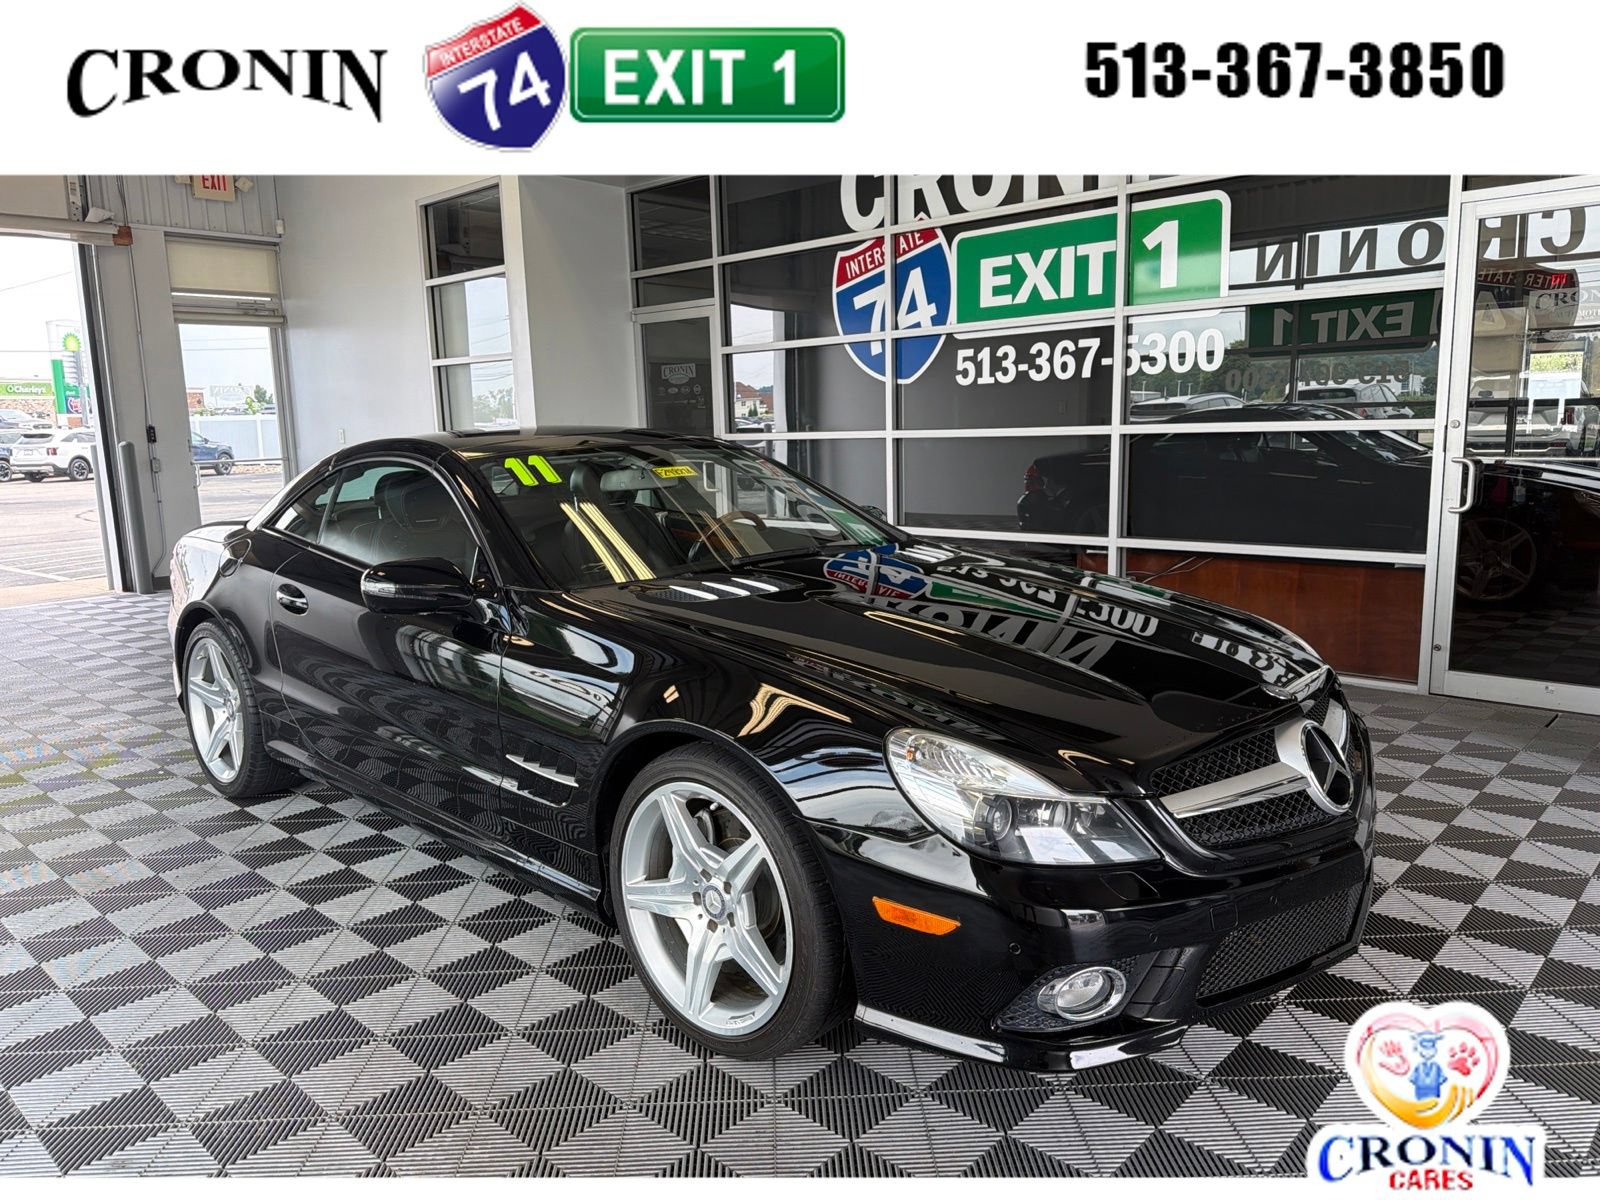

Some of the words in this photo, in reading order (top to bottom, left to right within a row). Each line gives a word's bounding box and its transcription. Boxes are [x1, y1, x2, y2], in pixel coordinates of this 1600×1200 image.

[202, 175, 227, 191] EXIT
[845, 230, 924, 279] INTERSATE
[980, 240, 1116, 308] EXIT
[1142, 220, 1179, 288] 1
[853, 266, 938, 356] 74
[955, 329, 1225, 386] 513-367-5300
[504, 455, 563, 487] 11
